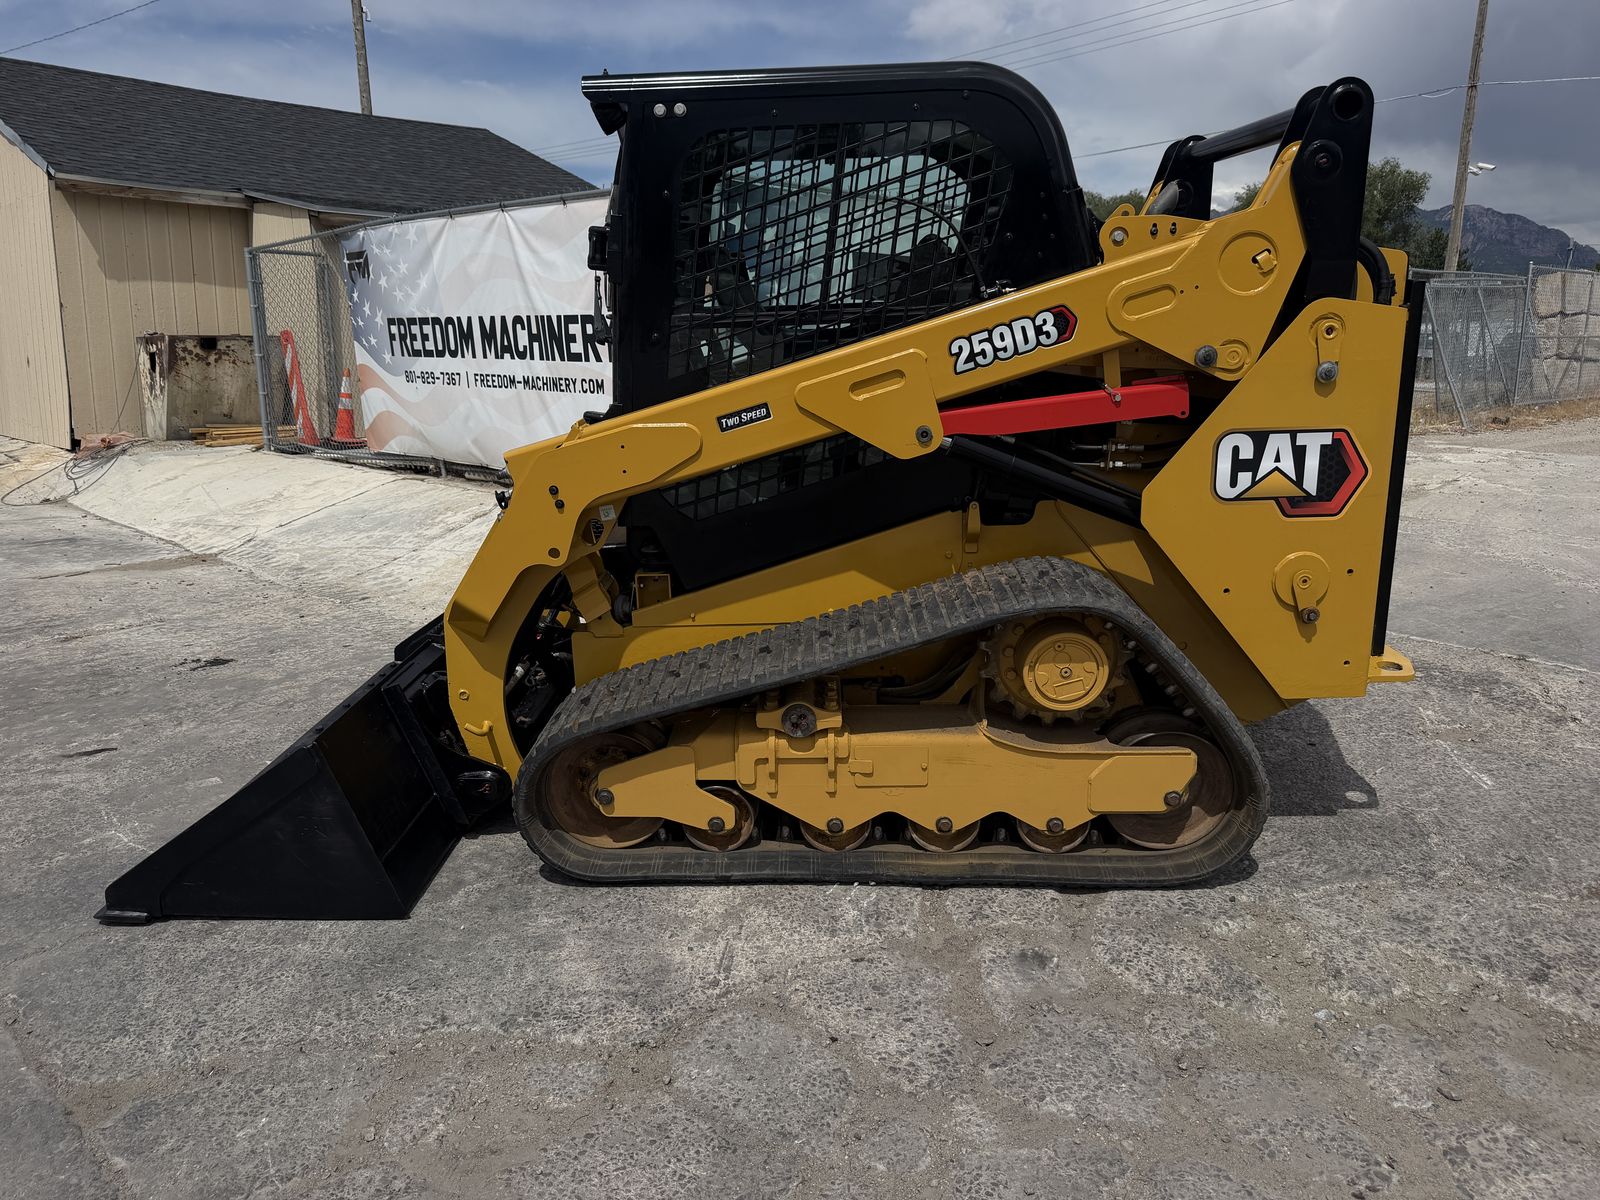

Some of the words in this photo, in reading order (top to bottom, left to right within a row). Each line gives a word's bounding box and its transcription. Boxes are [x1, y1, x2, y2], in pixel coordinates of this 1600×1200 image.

[387, 316, 476, 359] FREEDOM
[950, 311, 1058, 373] 259D3
[405, 370, 461, 386] 801-829-7367
[474, 373, 605, 394] FREEDOM-MACHINERY.COM
[1215, 432, 1333, 499] CAT
